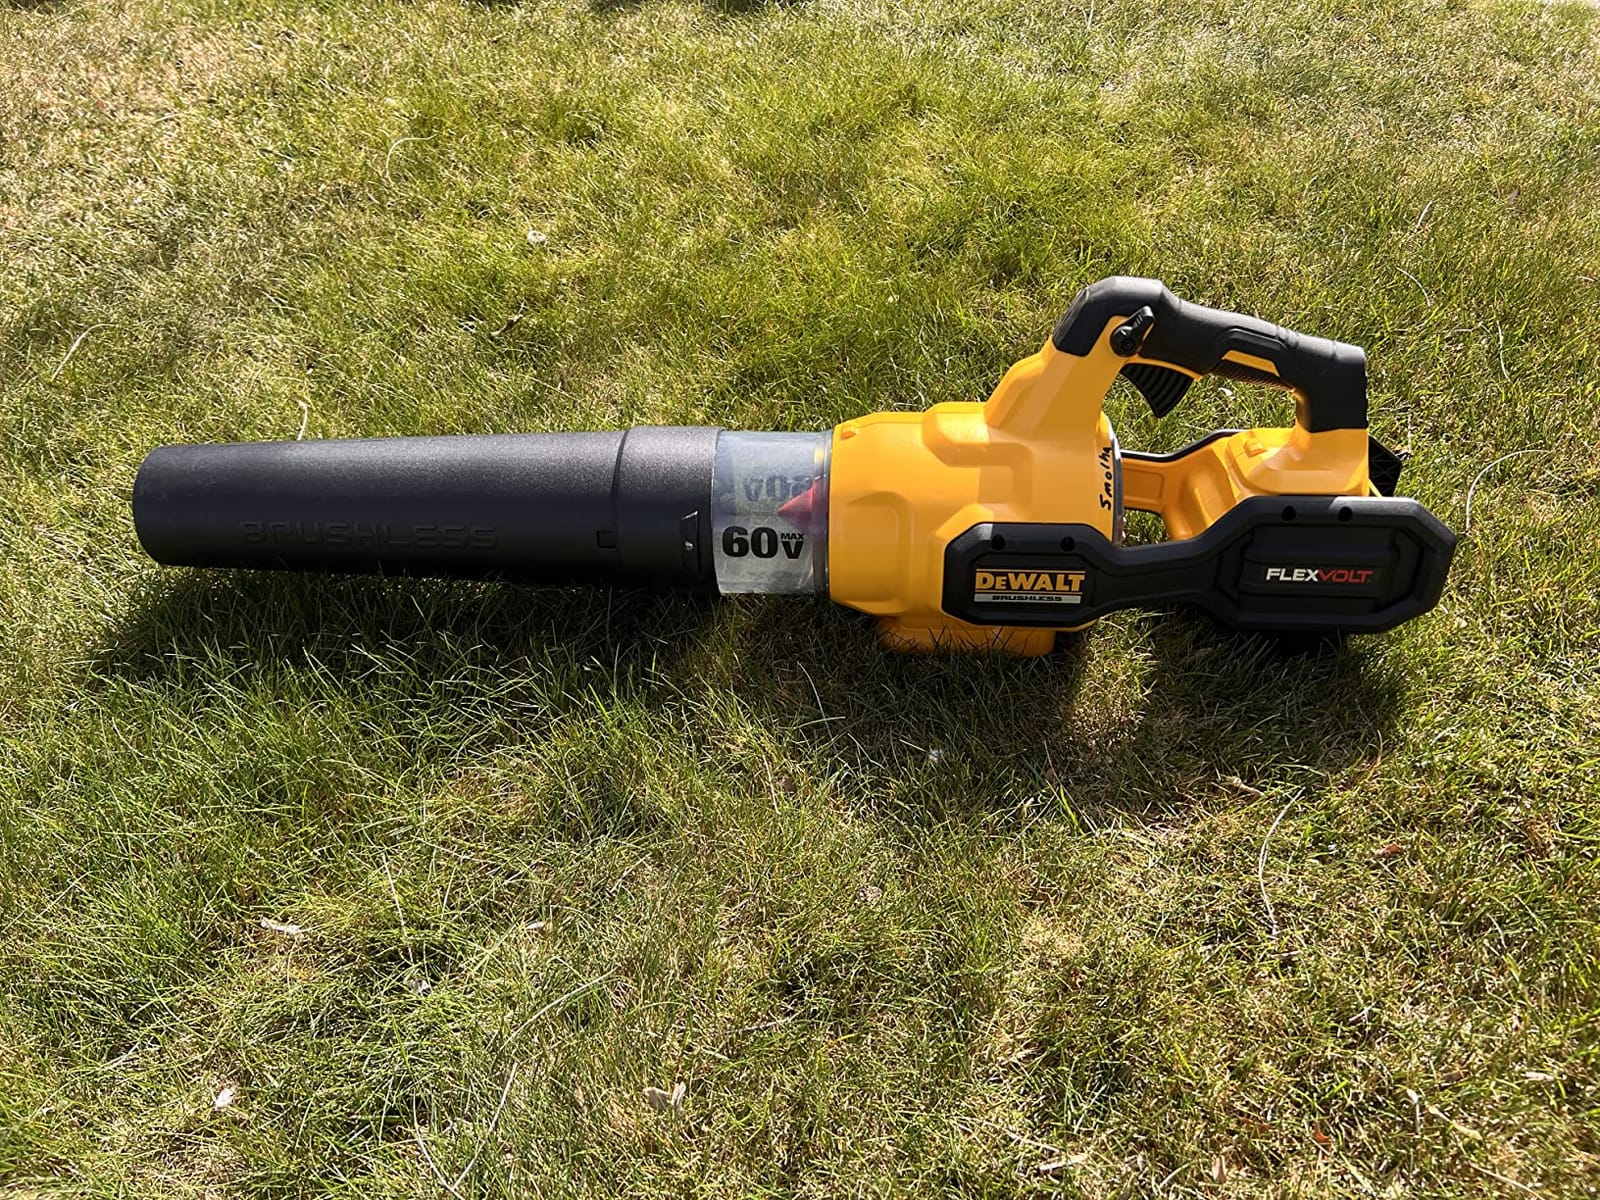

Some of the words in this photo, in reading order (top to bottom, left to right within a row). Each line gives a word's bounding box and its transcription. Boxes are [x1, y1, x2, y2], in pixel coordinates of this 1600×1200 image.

[239, 519, 497, 549] BRUSHLESS
[781, 533, 805, 541] MAX
[1266, 567, 1373, 584] FLEXVOLT
